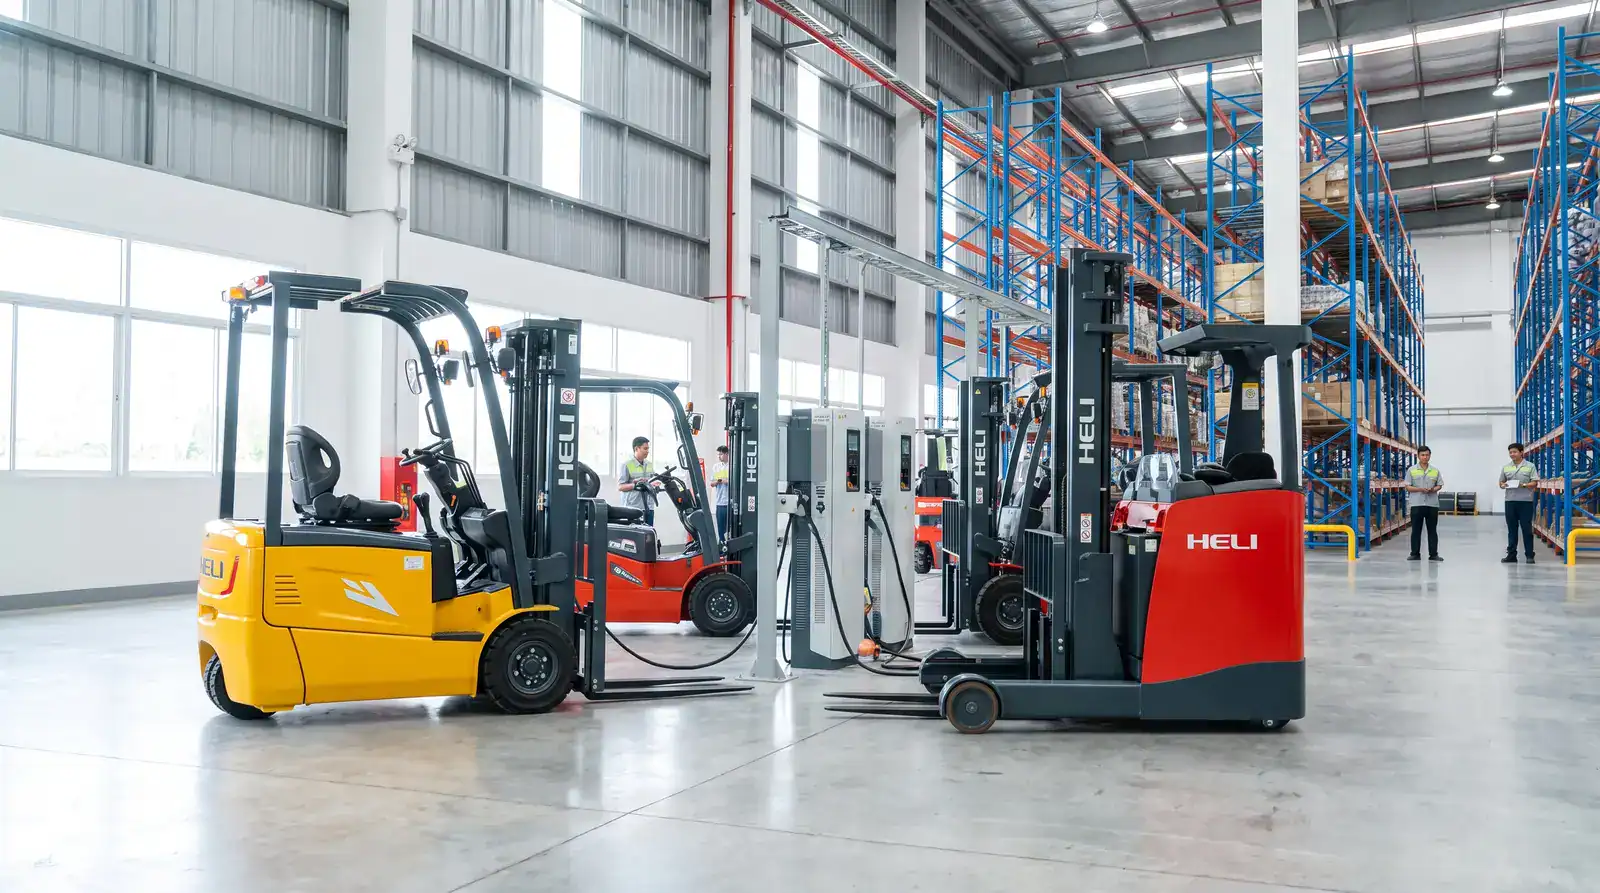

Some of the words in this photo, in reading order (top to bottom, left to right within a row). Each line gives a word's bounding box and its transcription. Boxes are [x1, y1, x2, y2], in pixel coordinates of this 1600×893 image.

[558, 414, 575, 486] HELI
[974, 429, 986, 476] HELI
[1079, 398, 1095, 464] HELI
[746, 440, 757, 482] HELI
[1187, 533, 1258, 550] HELI
